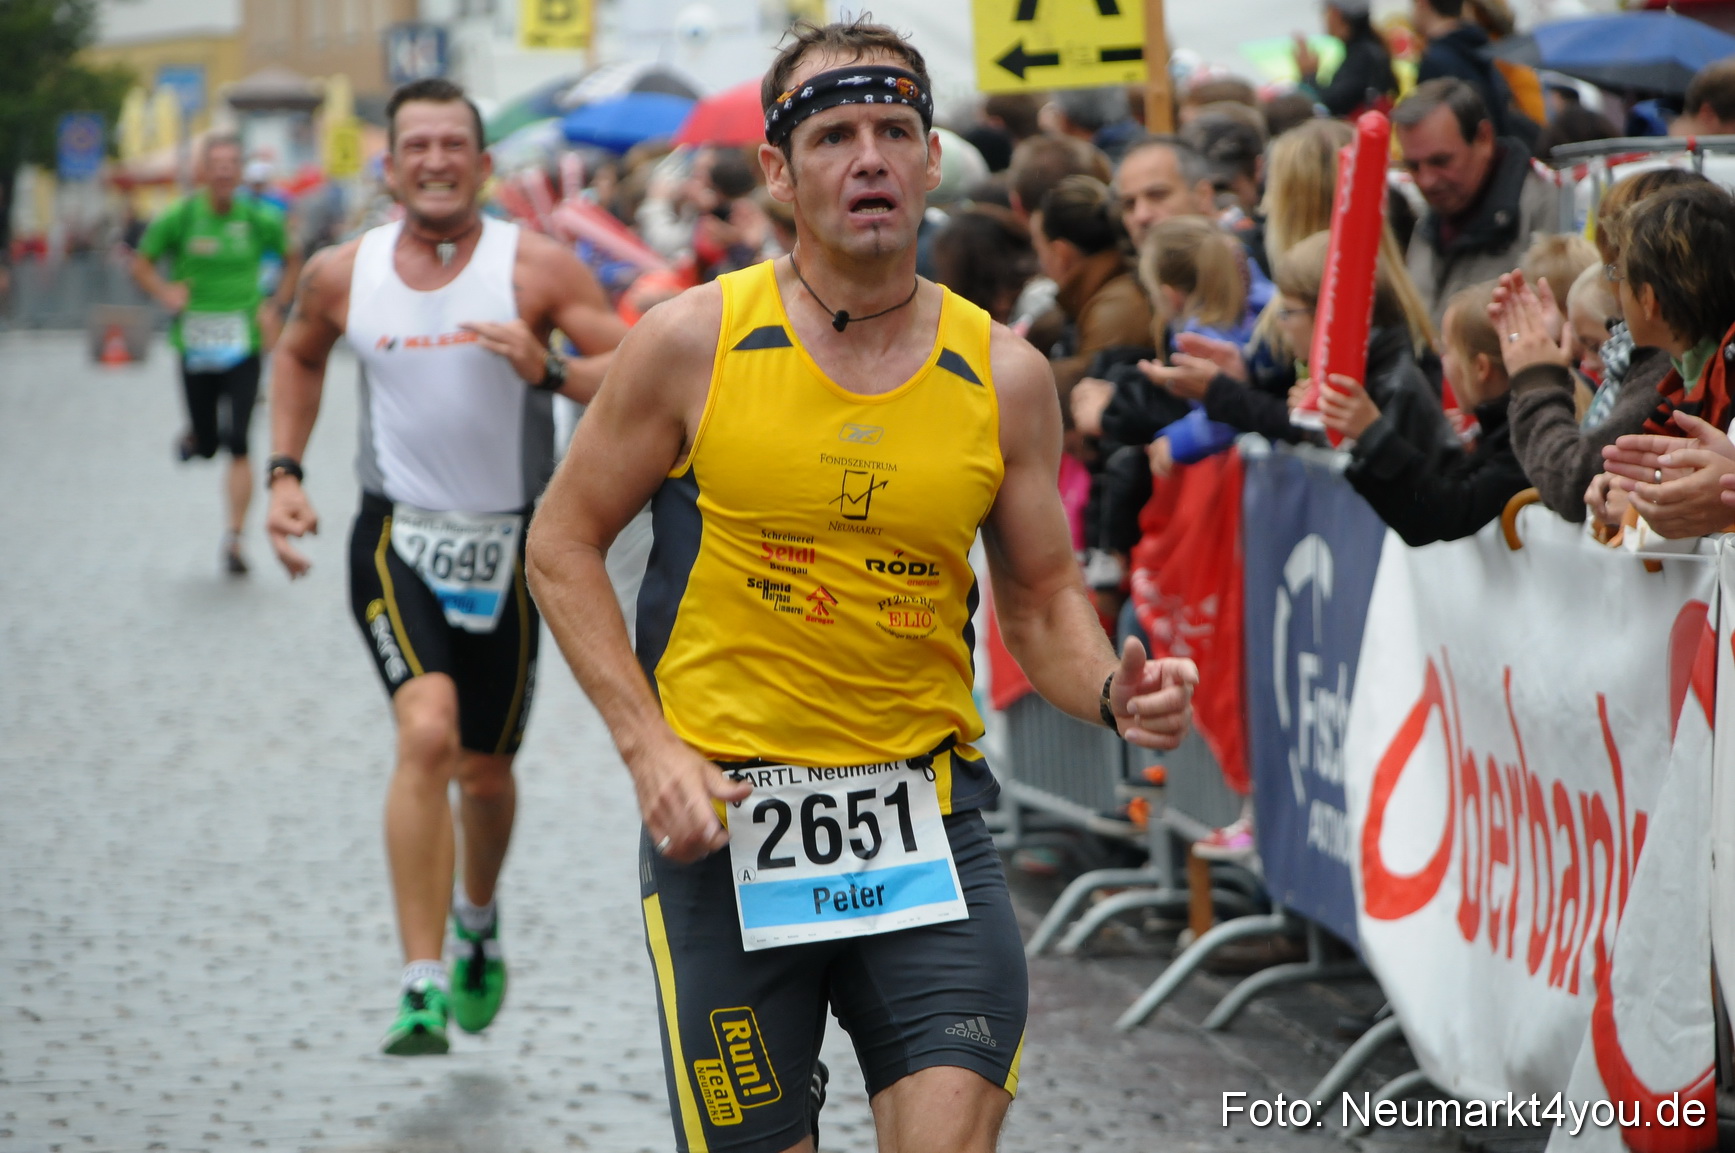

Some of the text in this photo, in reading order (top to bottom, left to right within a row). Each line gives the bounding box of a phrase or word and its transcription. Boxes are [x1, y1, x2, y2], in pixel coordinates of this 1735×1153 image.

[761, 529, 814, 544] Schreinerei
[760, 542, 816, 564] Seidl
[770, 562, 808, 575] Berngau
[888, 611, 932, 628] ELIO
[808, 760, 900, 782] Neumarkt
[752, 781, 918, 871] 2651
[1360, 645, 1649, 995] Oberbank
[813, 884, 886, 915] Peter
[944, 1026, 997, 1048] adidas
[721, 1018, 772, 1098] Run!
[696, 1066, 720, 1122] Neumarkt
[706, 1063, 736, 1121] Team
